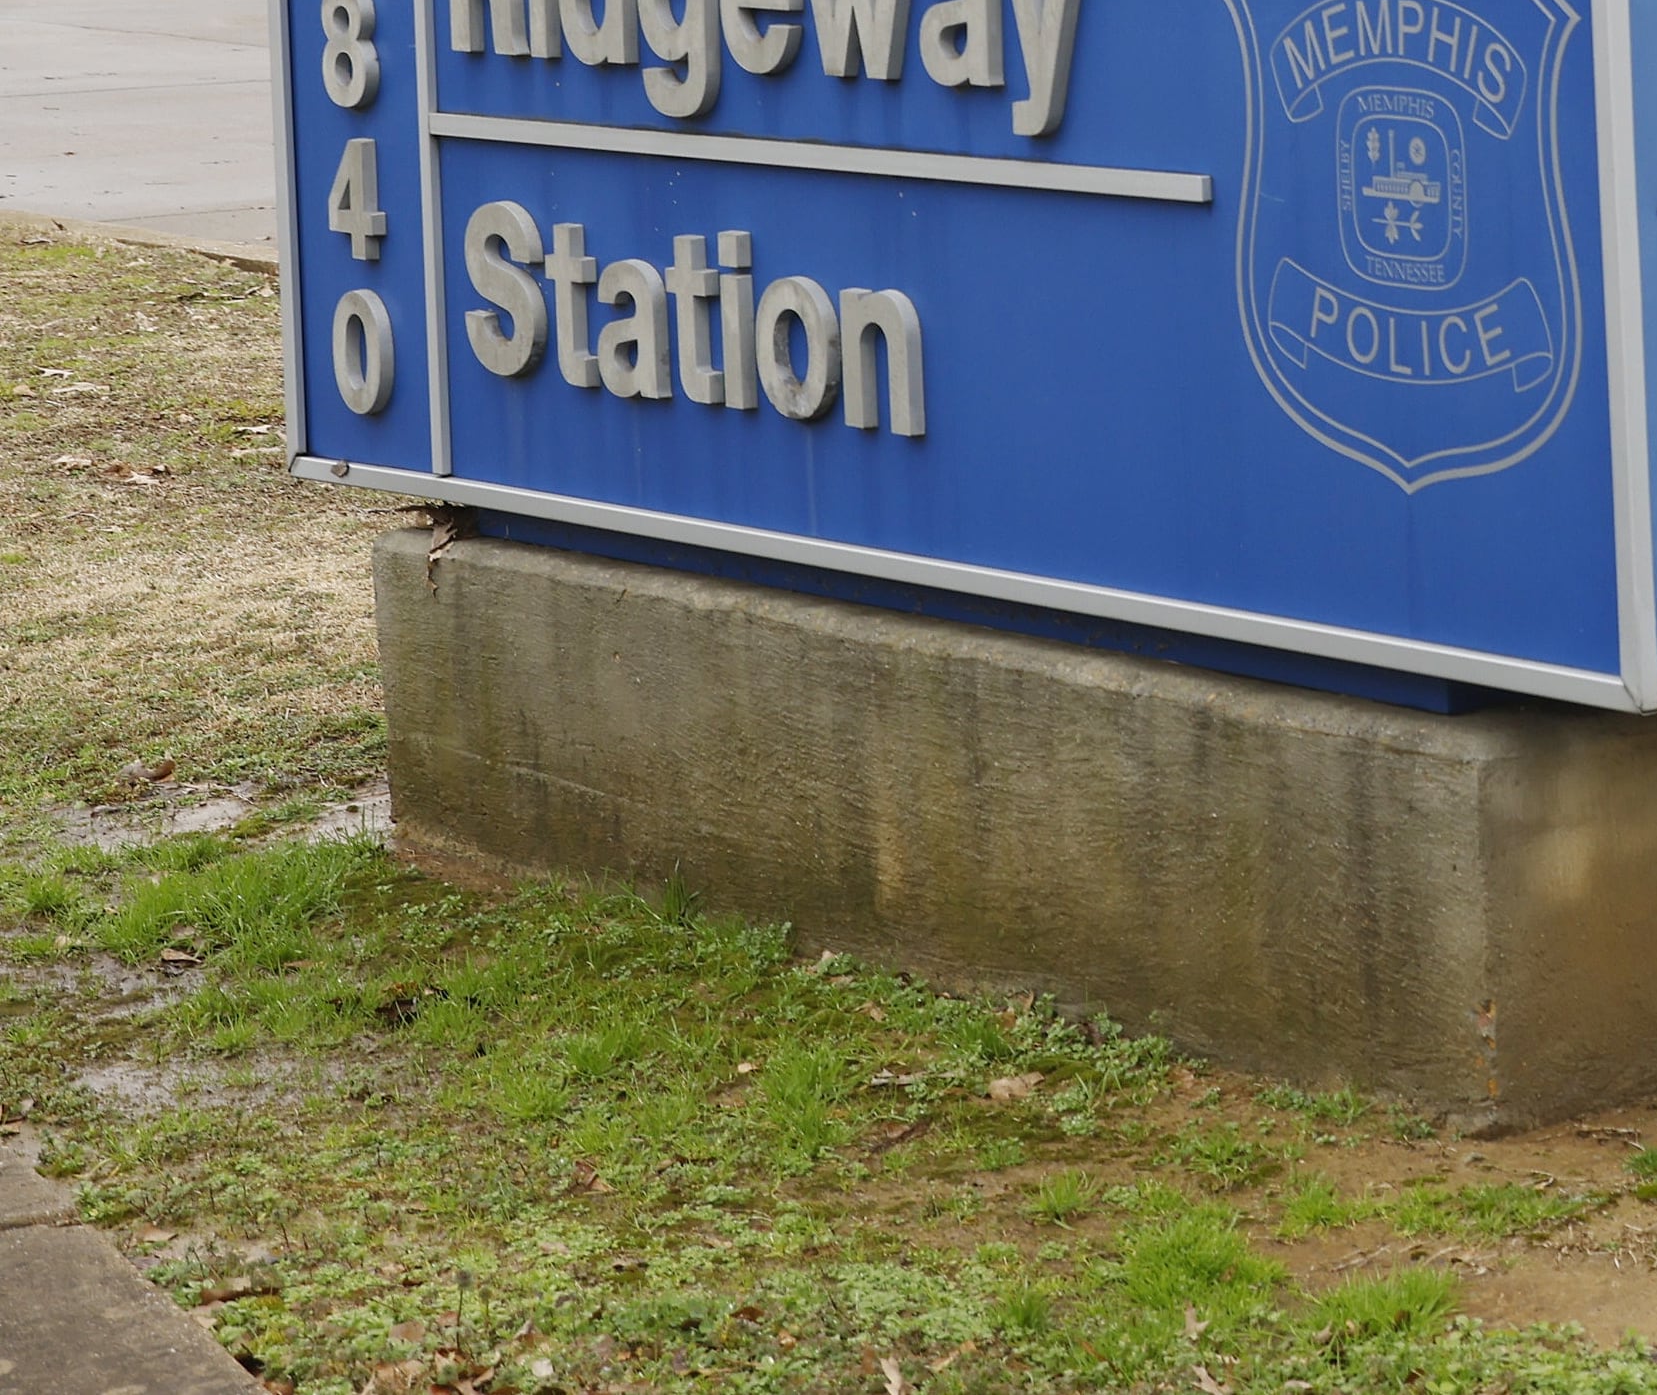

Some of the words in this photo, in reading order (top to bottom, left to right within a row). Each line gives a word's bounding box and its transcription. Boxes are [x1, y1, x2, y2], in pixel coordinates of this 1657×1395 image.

[1356, 93, 1435, 119] MEMPHIS
[1339, 139, 1353, 212] SHELBY
[1450, 148, 1465, 239] COUNTY
[1365, 255, 1446, 283] TENNESSEE
[464, 199, 926, 438] Station
[1310, 286, 1512, 376] POLICE
